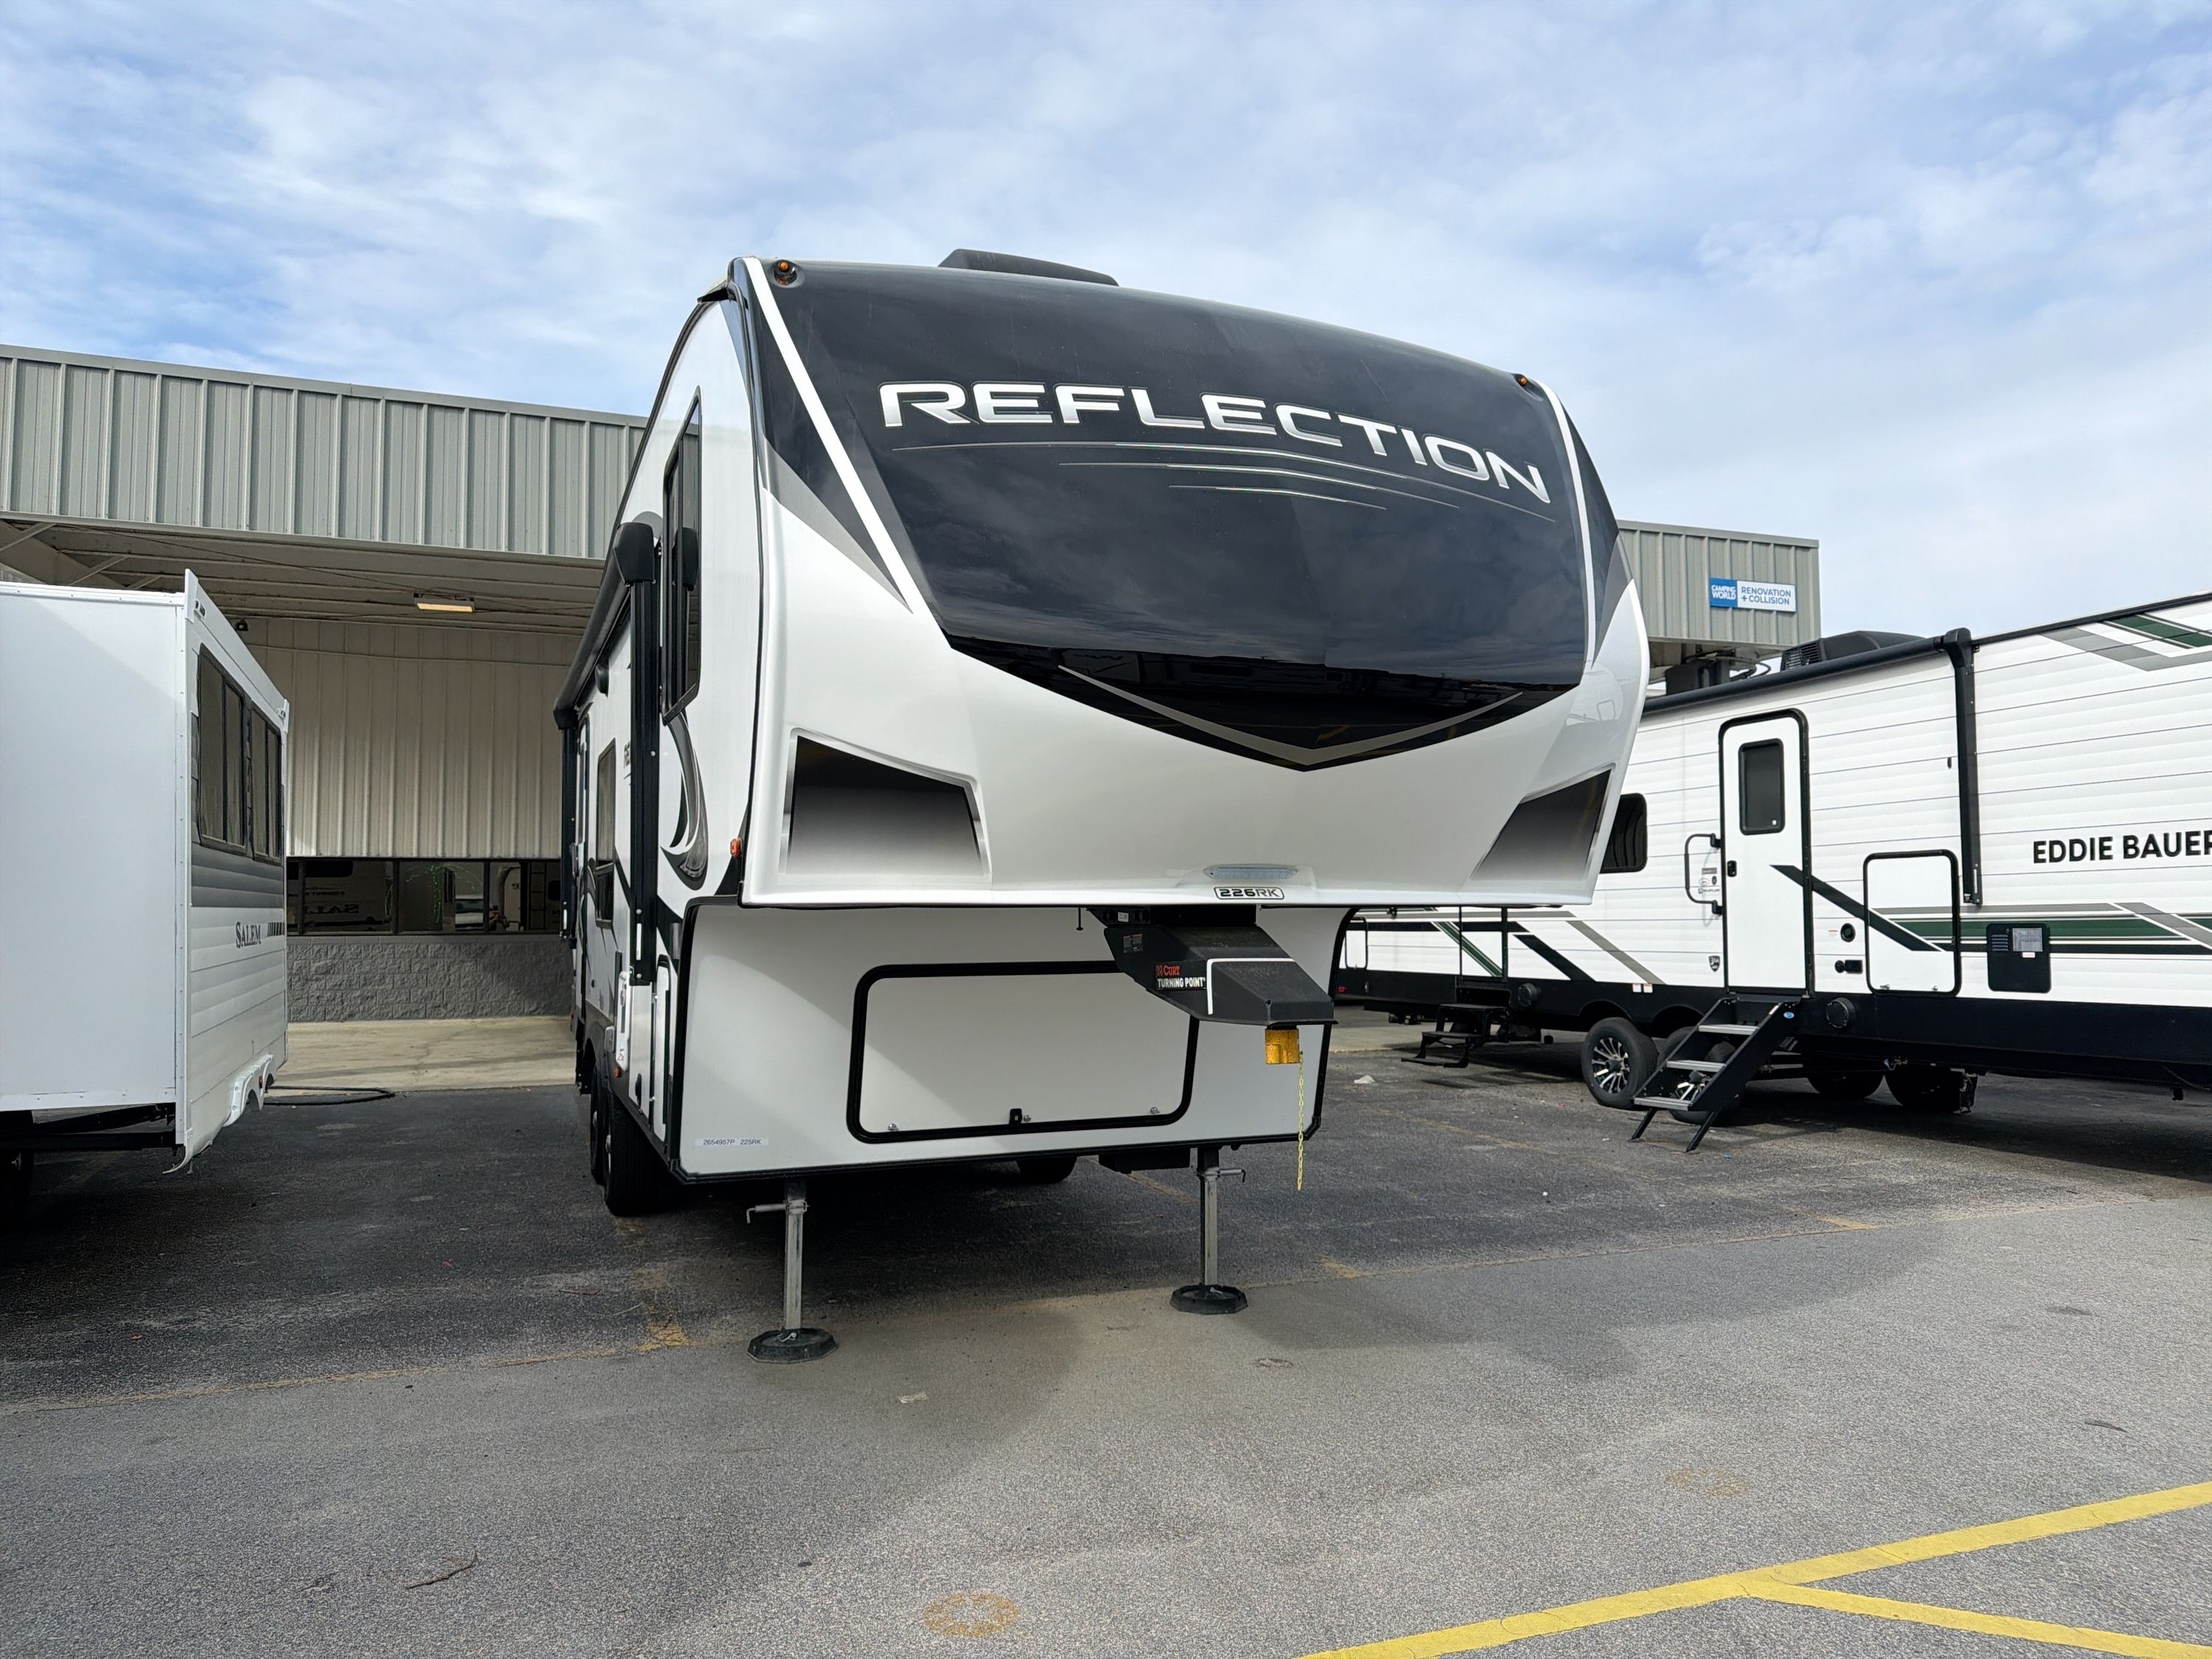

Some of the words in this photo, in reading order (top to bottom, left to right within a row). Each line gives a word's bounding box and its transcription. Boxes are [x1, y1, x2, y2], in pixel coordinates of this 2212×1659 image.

[878, 380, 1551, 504] REFLECTION
[1712, 591, 1736, 600] WORLD
[1741, 586, 1791, 597] RENOVATION
[1748, 595, 1790, 605] COLLISION
[2034, 836, 2113, 863] EDDIE
[1219, 888, 1281, 897] 226RK
[1157, 978, 1184, 988] TURNING
